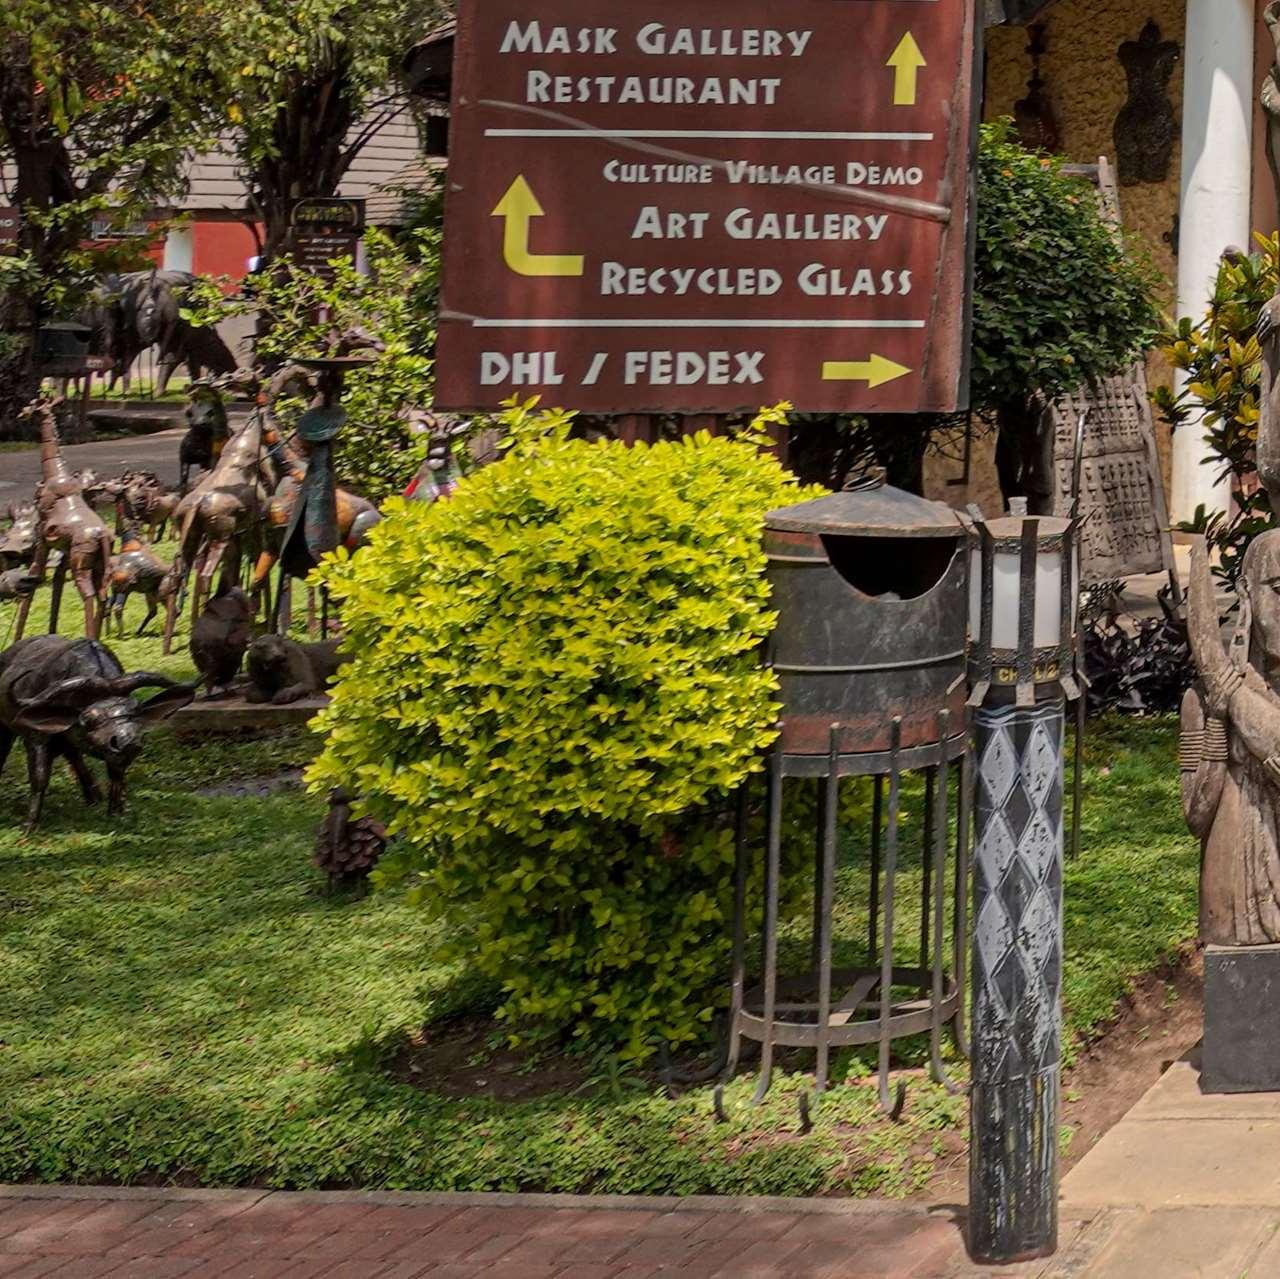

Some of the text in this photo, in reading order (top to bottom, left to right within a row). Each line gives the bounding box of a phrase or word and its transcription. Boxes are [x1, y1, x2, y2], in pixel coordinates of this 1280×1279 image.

[499, 20, 812, 57] MASK GALLERY
[526, 70, 781, 105] RESTAURANT
[603, 159, 923, 186] CULTURE VILLAGE DEMO
[631, 206, 889, 241] ART GALLERY
[601, 261, 912, 296] RECYCLED GLASS
[480, 350, 766, 385] DHL / FEDEX
